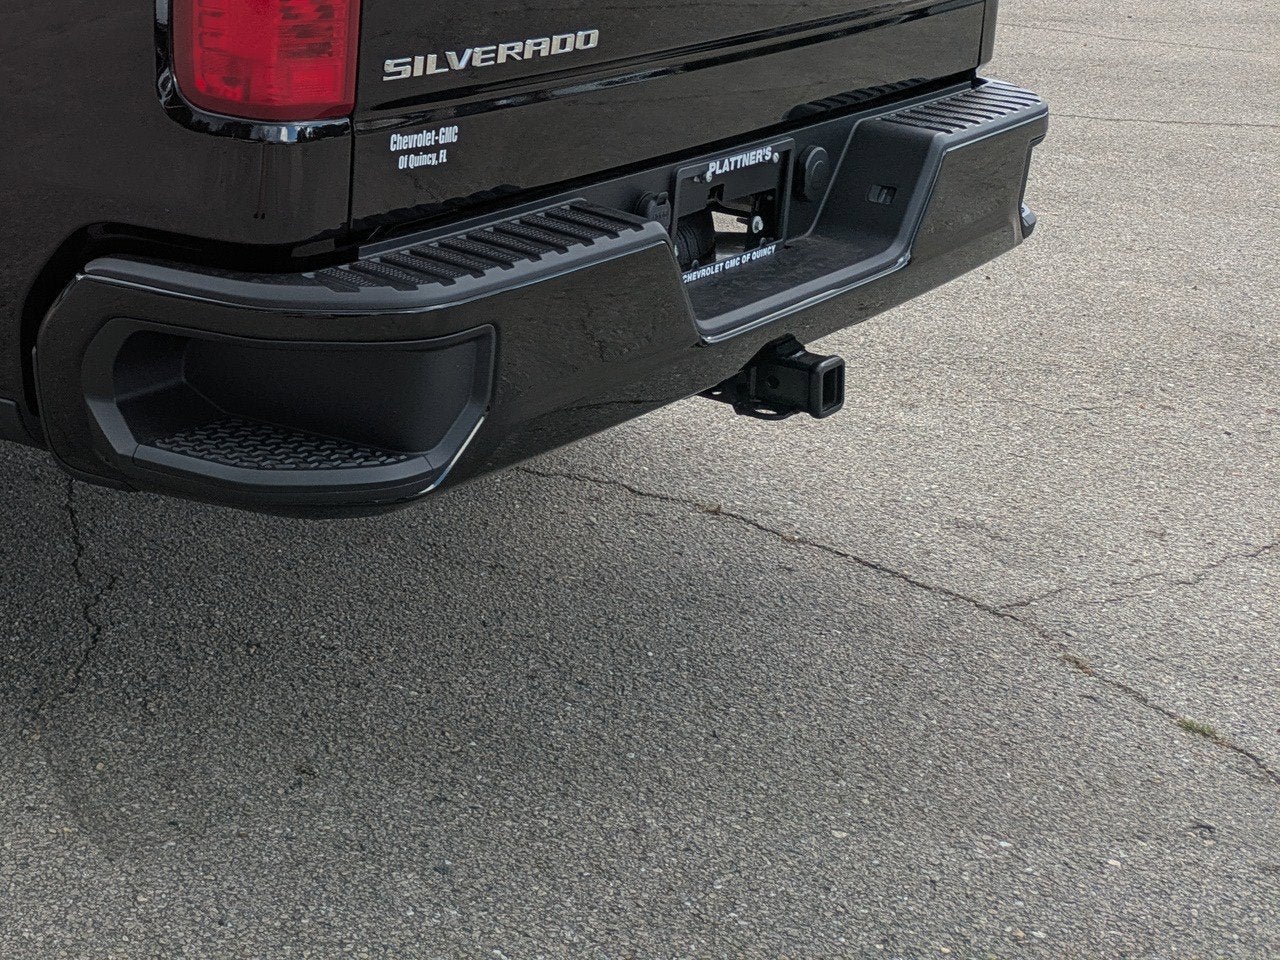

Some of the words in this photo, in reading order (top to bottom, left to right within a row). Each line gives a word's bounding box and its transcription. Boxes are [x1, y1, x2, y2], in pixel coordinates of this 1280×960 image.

[382, 29, 599, 81] SILVERADO
[398, 155, 408, 170] Of
[408, 152, 438, 169] Quincy,
[439, 149, 447, 163] FL
[709, 147, 772, 175] PLATTNER'S
[682, 263, 723, 283] CHEVROLET
[725, 257, 740, 269] GMC
[742, 253, 751, 264] OF
[752, 245, 776, 260] QUINCY
